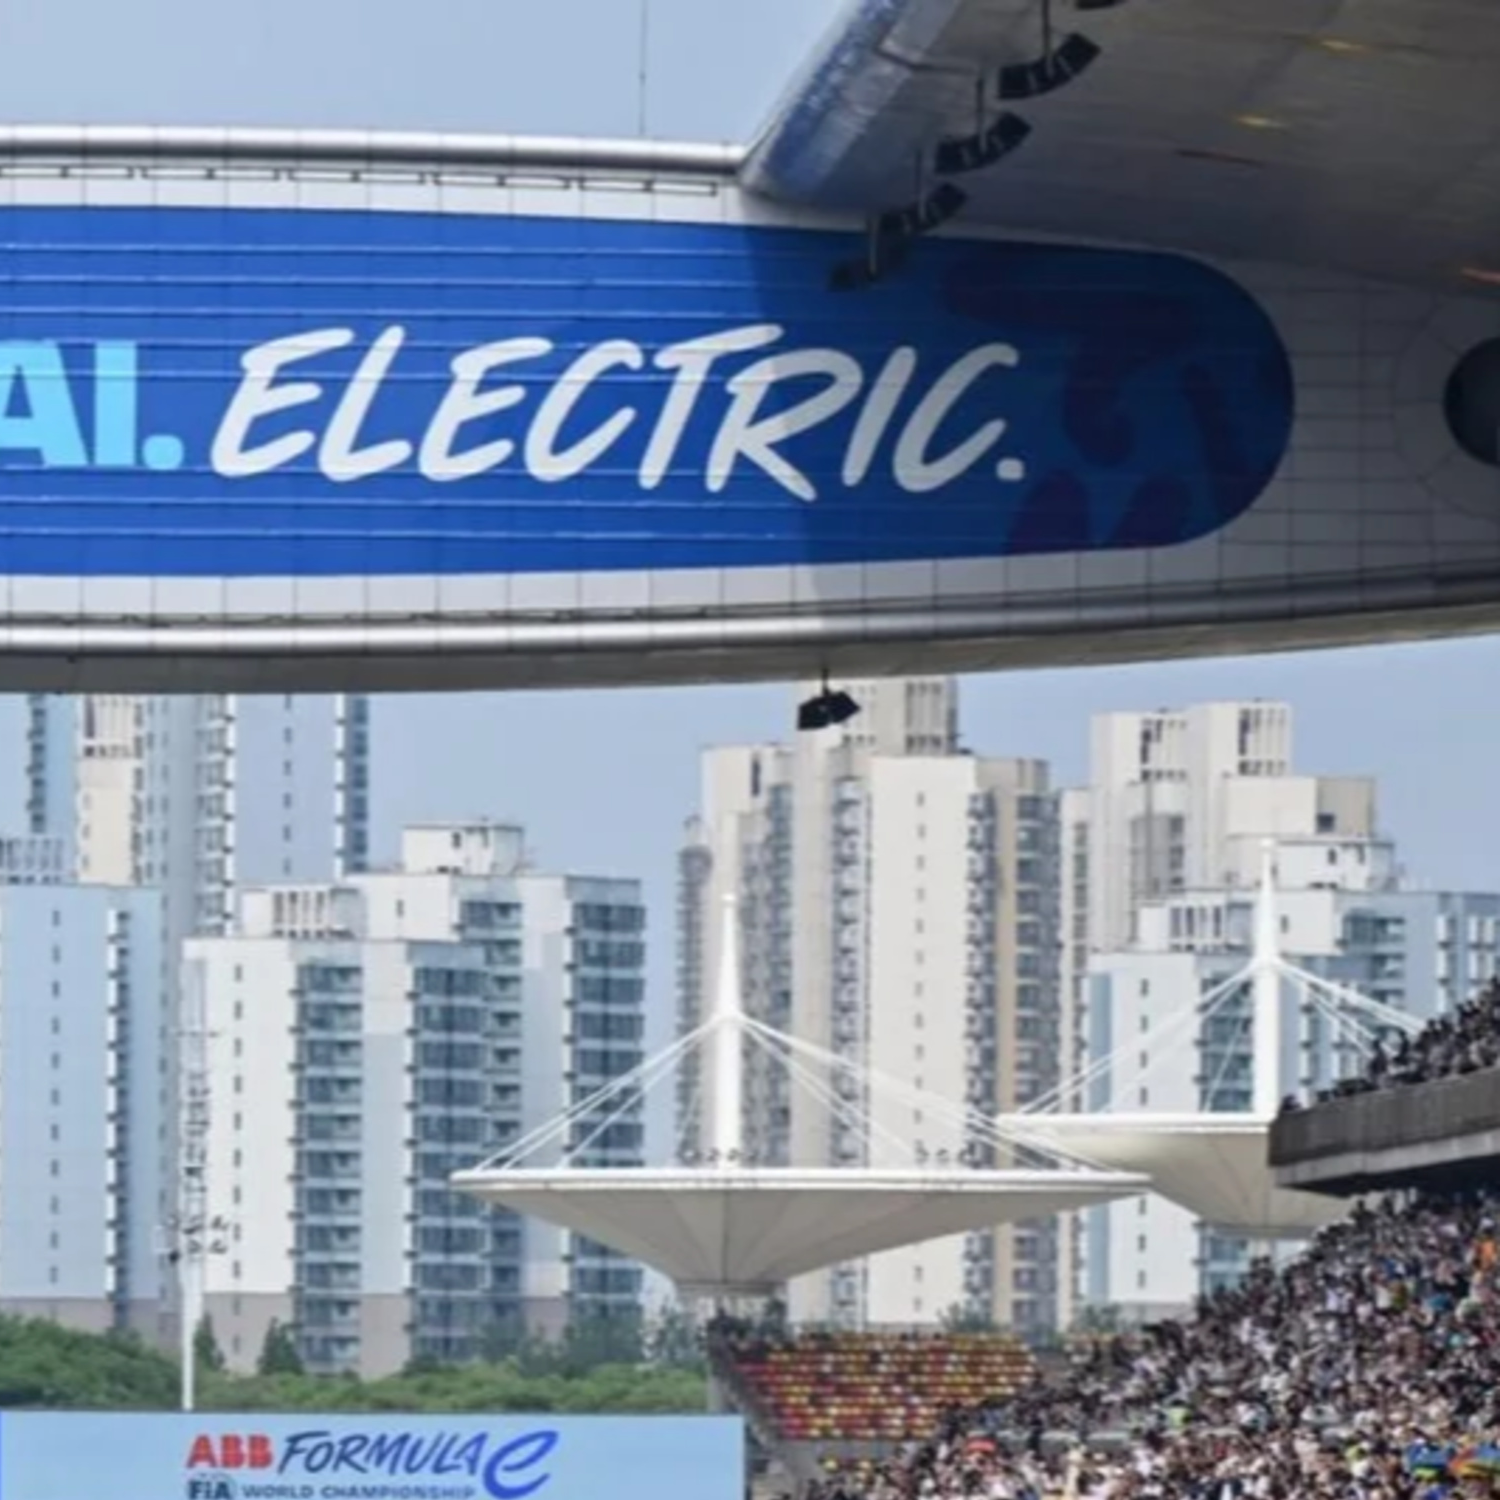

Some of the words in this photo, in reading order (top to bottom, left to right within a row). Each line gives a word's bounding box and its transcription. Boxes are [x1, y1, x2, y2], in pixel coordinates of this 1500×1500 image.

[210, 324, 1025, 502] ELECTRIC.
[186, 1433, 274, 1469] ABB
[277, 1430, 489, 1476] FORMULA
[241, 1484, 314, 1500] WORLD
[320, 1483, 476, 1500] CHAMPIONSHIP
